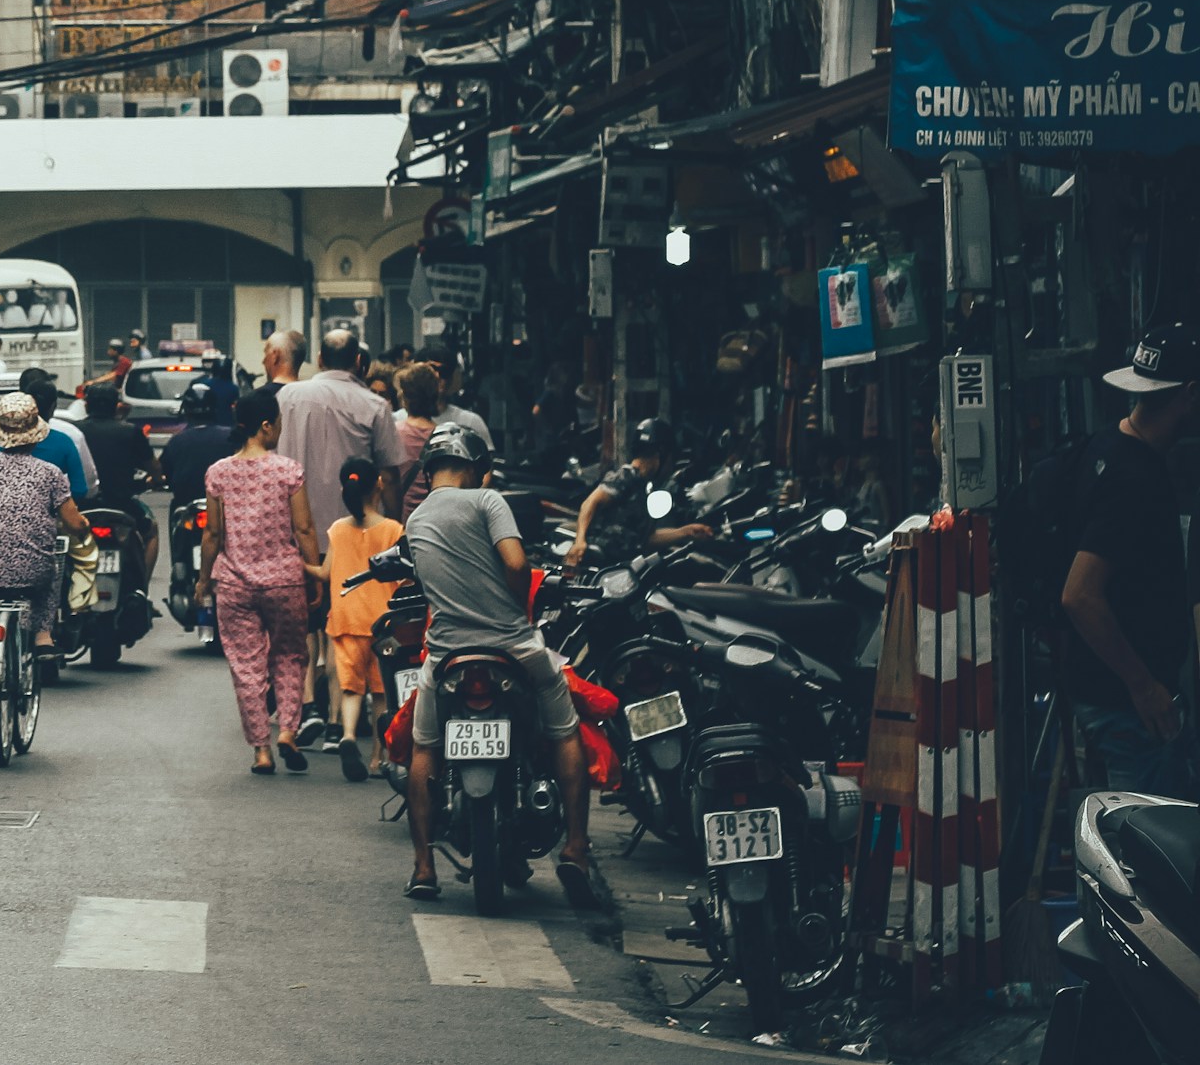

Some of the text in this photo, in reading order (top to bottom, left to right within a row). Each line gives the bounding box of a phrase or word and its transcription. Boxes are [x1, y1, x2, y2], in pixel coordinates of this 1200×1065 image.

[915, 80, 1015, 118] CHUYÊN:
[1023, 79, 1062, 118] MỸ
[1068, 70, 1142, 117] PHẨM
[916, 129, 934, 146] CH
[937, 129, 951, 146] 14
[1037, 129, 1093, 147] 39260379
[957, 362, 983, 406] BNE
[456, 723, 500, 739] 29-D1
[450, 740, 505, 756] 066.59
[716, 836, 772, 860] 3121
